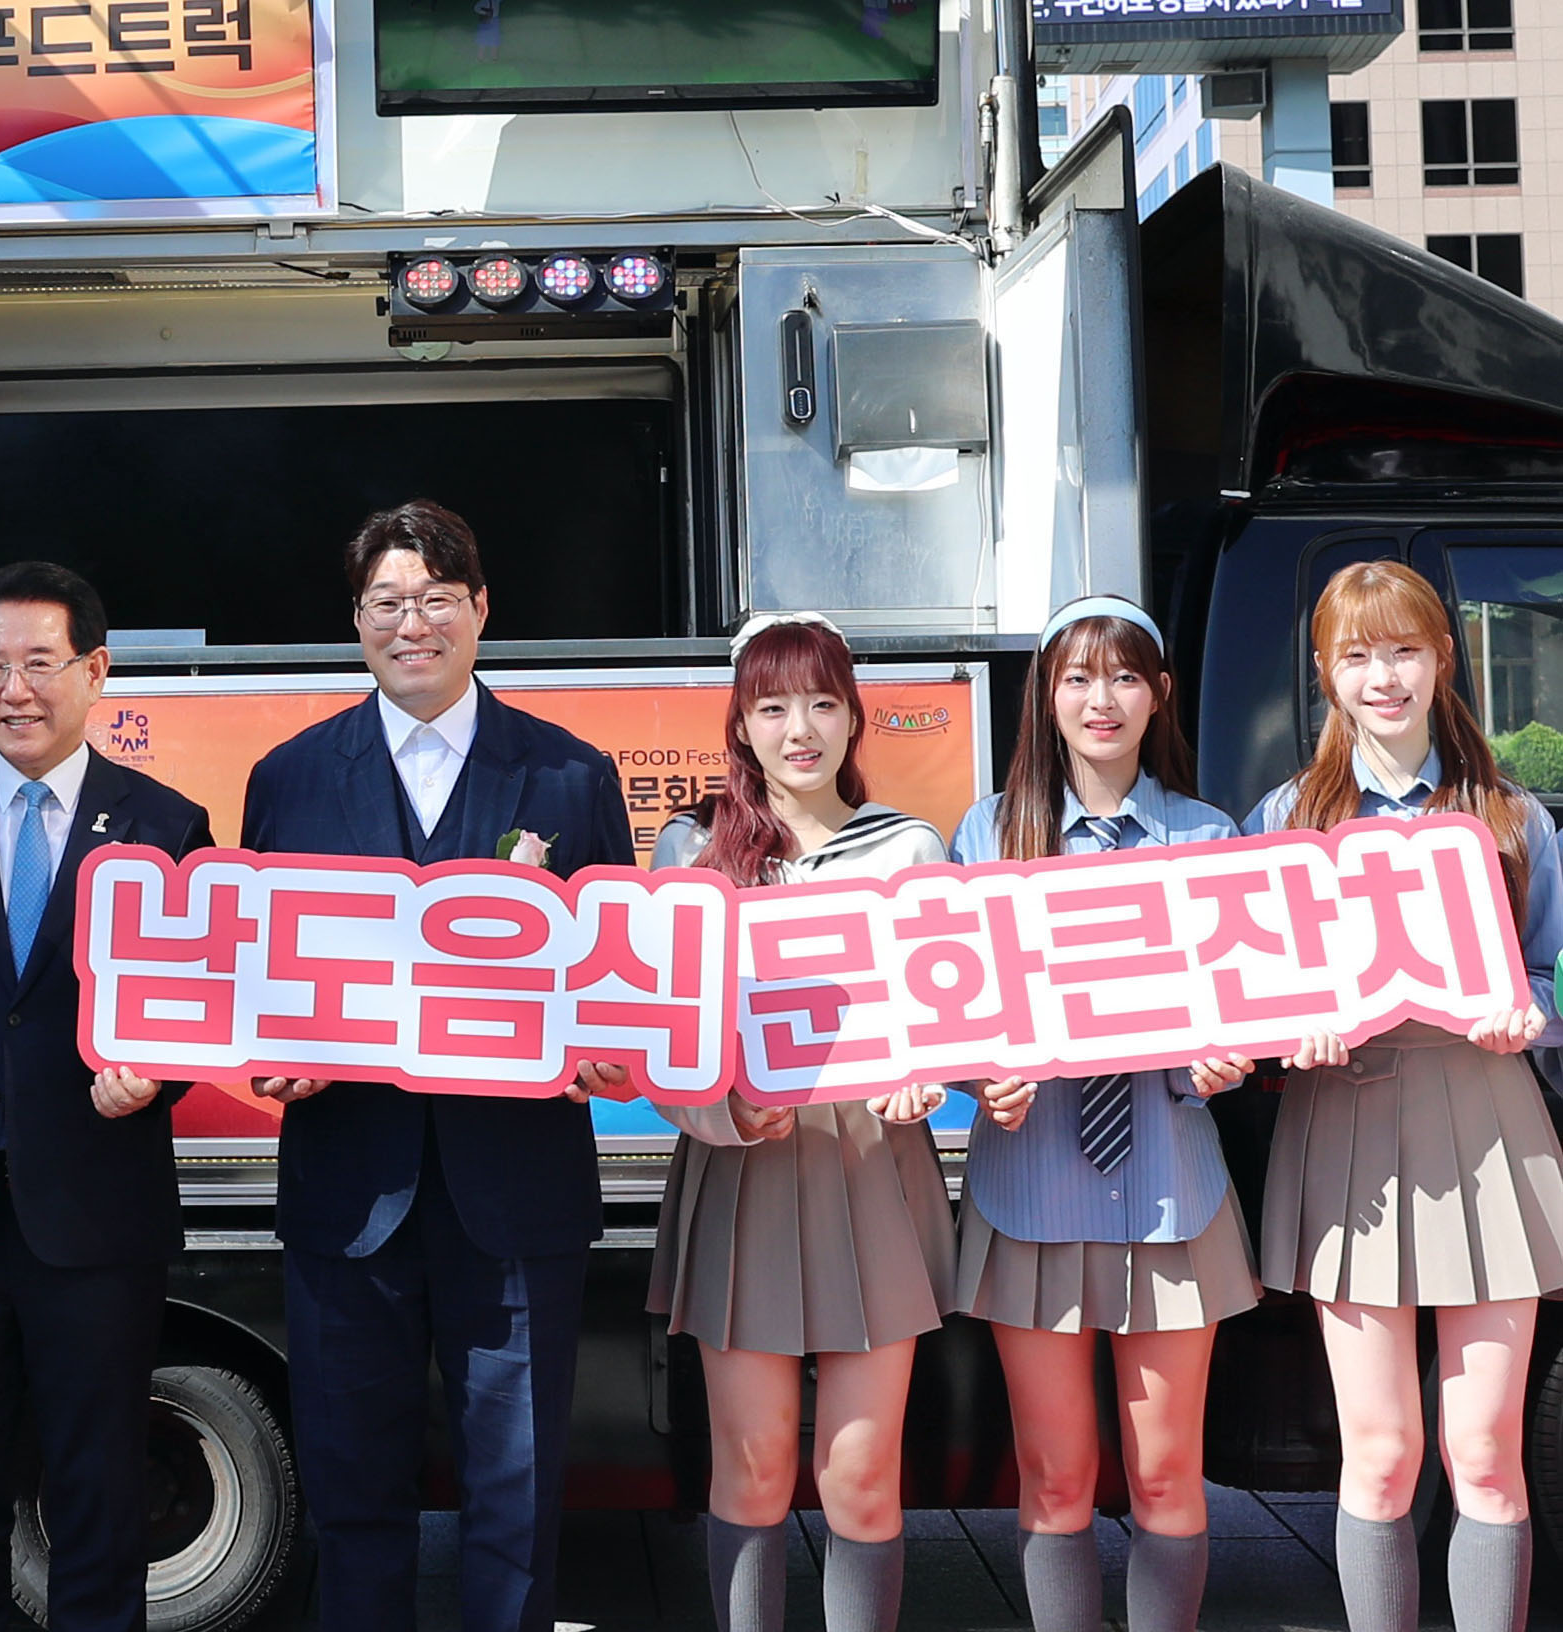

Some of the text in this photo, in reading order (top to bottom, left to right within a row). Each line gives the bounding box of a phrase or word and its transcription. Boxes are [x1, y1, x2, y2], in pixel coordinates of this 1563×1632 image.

[619, 749, 729, 766] FOOD Fest
[873, 706, 949, 729] NAMDO
[110, 880, 703, 1069] 남도음식
[748, 847, 1491, 1070] 문화큰잔치
